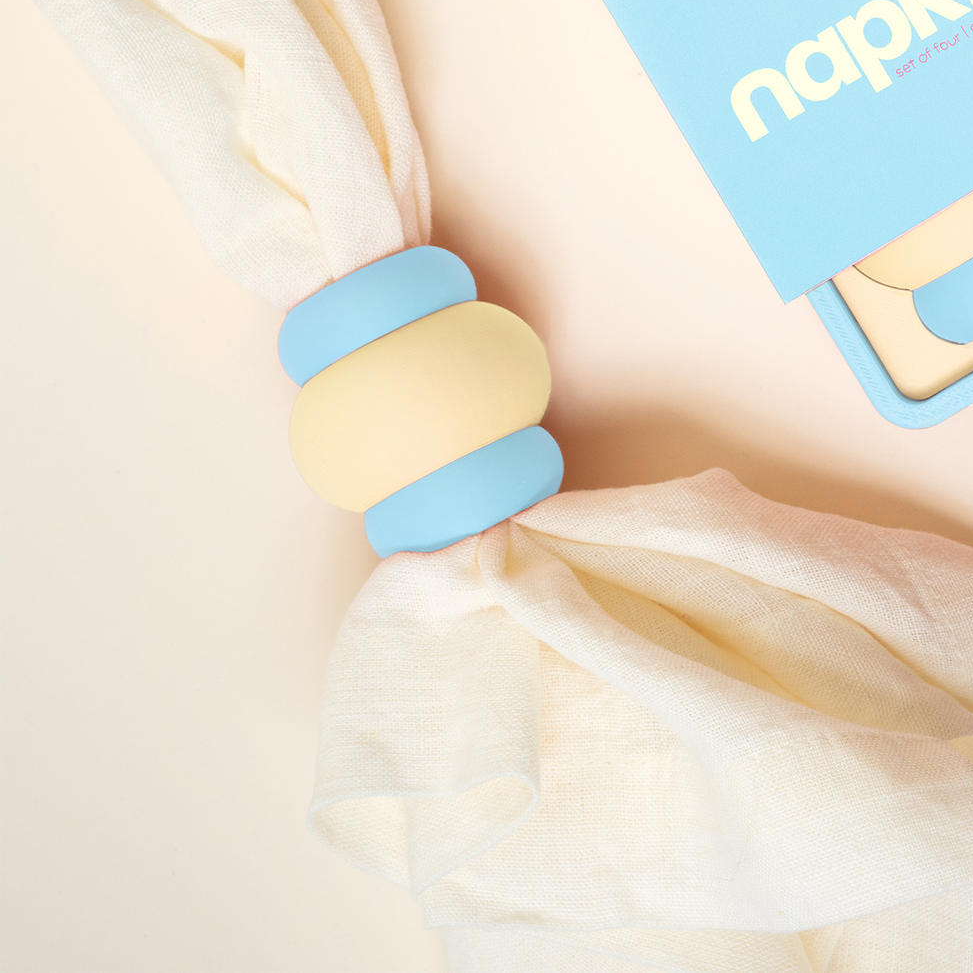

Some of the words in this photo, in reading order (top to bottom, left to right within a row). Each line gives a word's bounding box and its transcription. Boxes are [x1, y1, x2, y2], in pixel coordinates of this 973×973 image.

[895, 59, 916, 78] set
[918, 47, 932, 63] of
[933, 33, 960, 54] four
